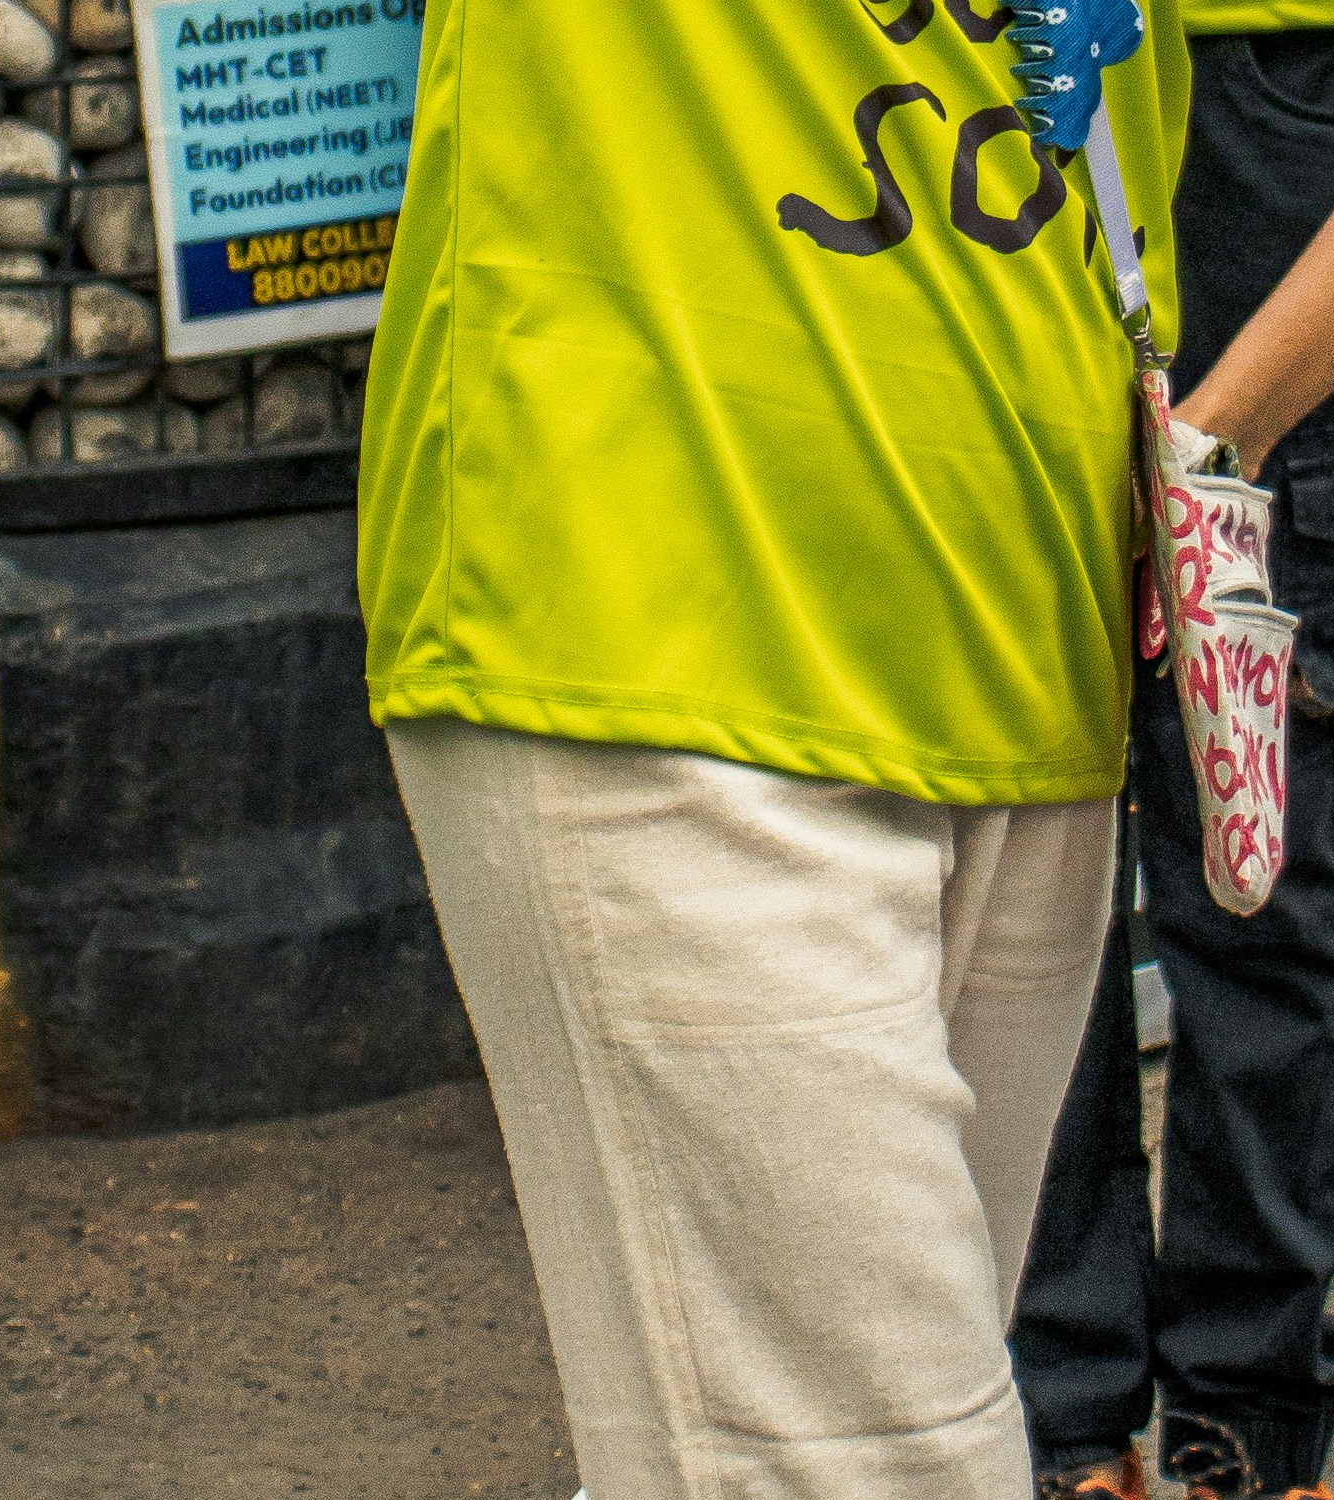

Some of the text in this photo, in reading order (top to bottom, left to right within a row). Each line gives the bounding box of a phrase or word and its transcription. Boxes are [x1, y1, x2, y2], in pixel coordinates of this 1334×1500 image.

[176, 47, 329, 93] MHT-CET
[180, 76, 399, 131] Medical (NEET)
[184, 121, 368, 174] Engineering
[188, 167, 364, 217] Foundation
[226, 216, 398, 273] LAW COLLE
[252, 252, 392, 305] 880090
